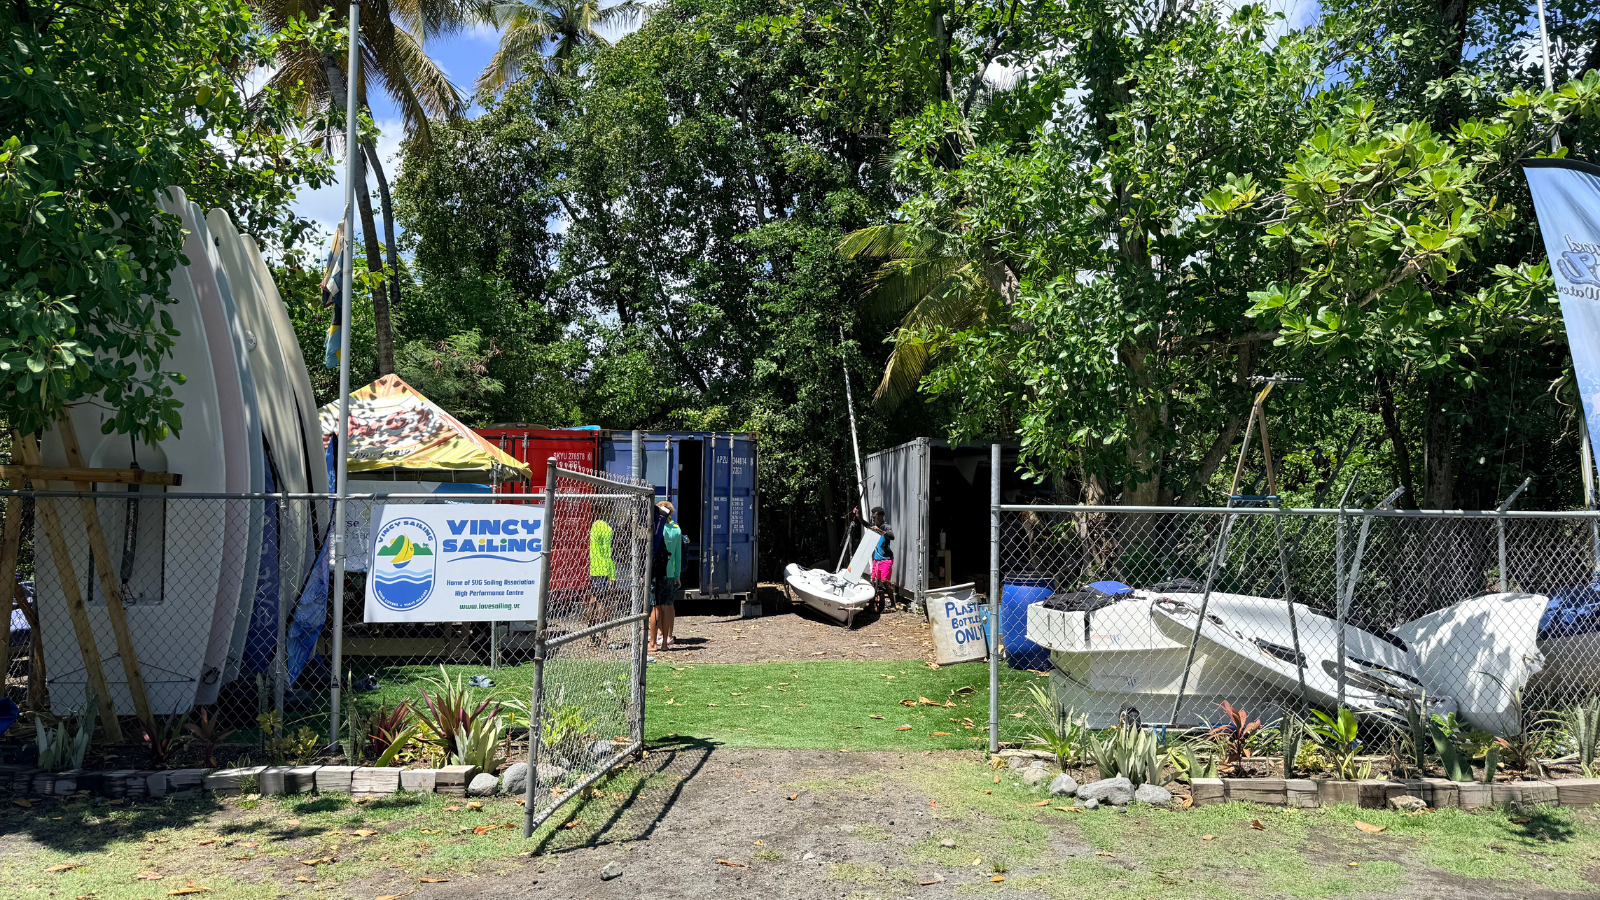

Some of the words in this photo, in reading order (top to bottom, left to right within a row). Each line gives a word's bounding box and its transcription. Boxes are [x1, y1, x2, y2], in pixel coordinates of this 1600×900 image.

[378, 521, 401, 543] VINCY
[403, 520, 434, 542] SAILING
[446, 519, 541, 536] VINCY
[484, 579, 503, 587] Sailing
[503, 578, 536, 586] Association
[454, 590, 468, 598] High
[469, 589, 505, 597] Performance
[944, 601, 978, 618] PLAST
[955, 624, 983, 645] ONLY
